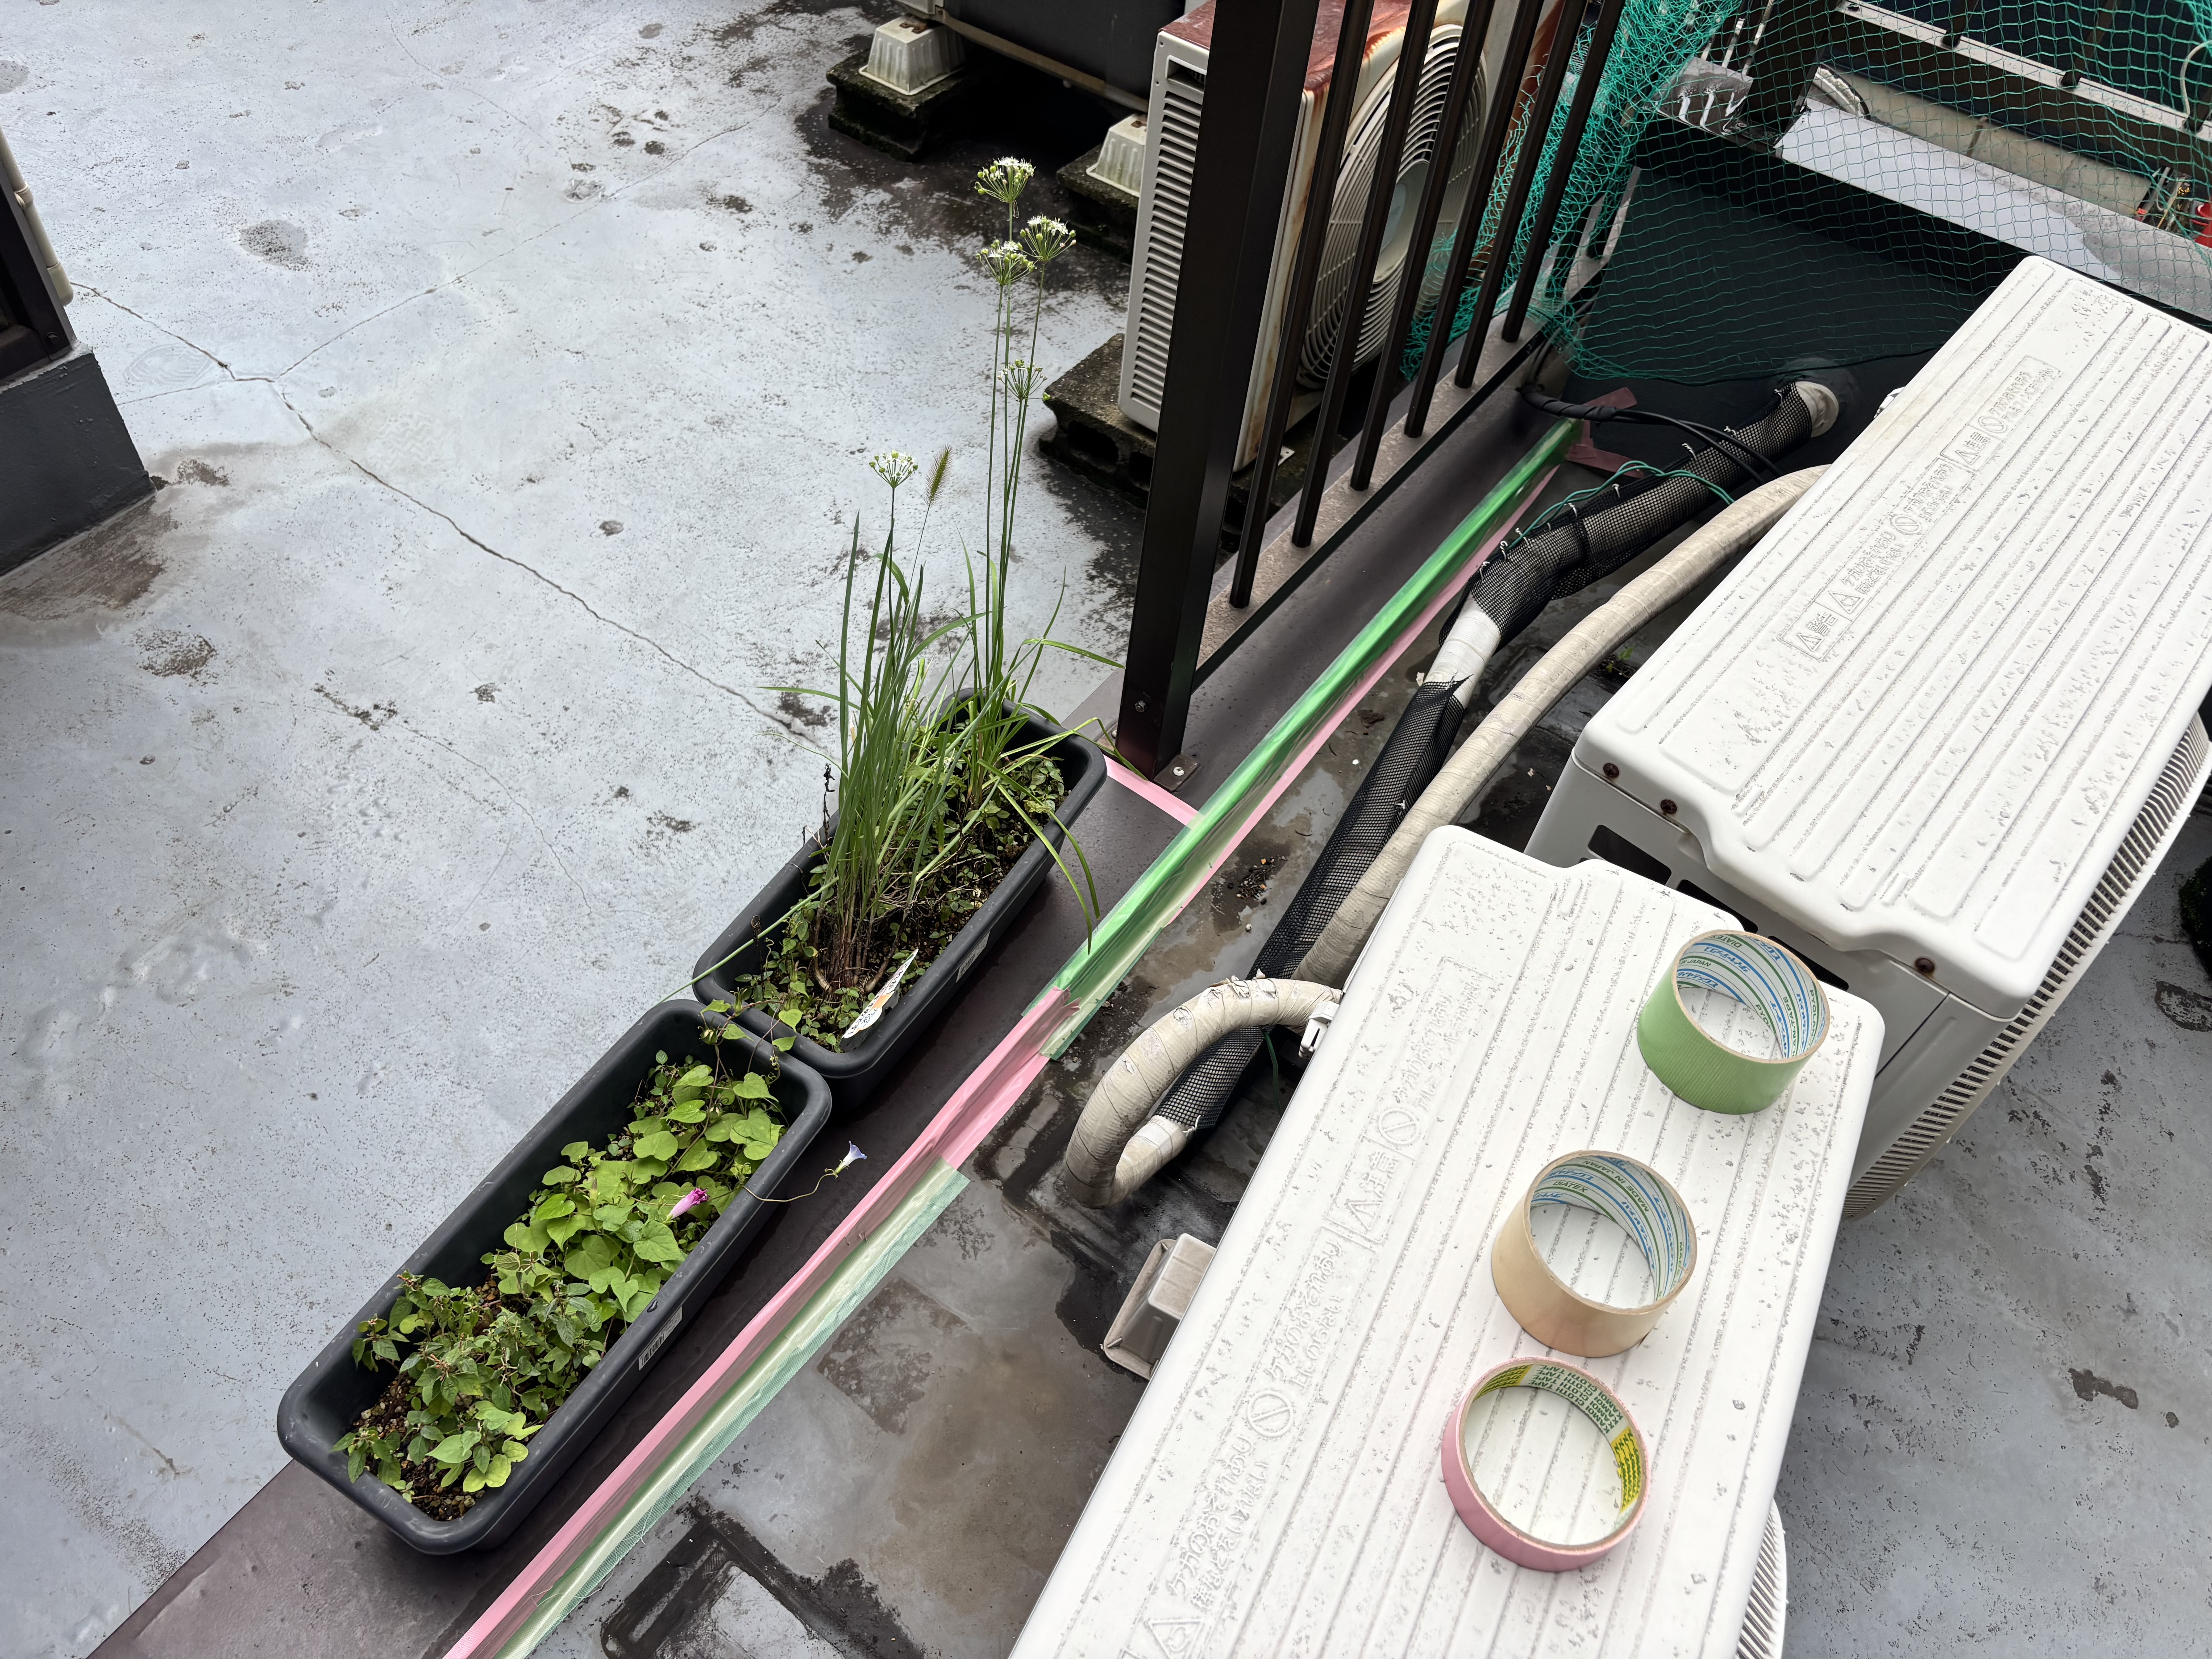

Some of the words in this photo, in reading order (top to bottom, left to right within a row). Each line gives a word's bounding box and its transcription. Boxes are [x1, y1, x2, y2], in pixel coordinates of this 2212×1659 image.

[1686, 958, 1711, 967] JAPAN
[1359, 1147, 1401, 1197] 注意
[1583, 1160, 1614, 1173] JAPAN
[1614, 1175, 1626, 1183] IN
[1552, 1181, 1588, 1192] DIATEX
[1625, 1185, 1649, 1212] MADE
[1265, 1239, 1344, 1380] ケガのおそれあり
[1289, 1295, 1344, 1390] 上にのらない
[1555, 1386, 1585, 1407] CLOTH
[1559, 1381, 1589, 1401] CLOTH
[1563, 1376, 1594, 1397] CLOTH
[1585, 1405, 1610, 1433] KAMOI
[1589, 1401, 1615, 1429] KAMOI
[1593, 1396, 1619, 1424] KAMOI
[1597, 1391, 1623, 1420] KAMOI
[1166, 1434, 1255, 1597] ケガのおそれあり
